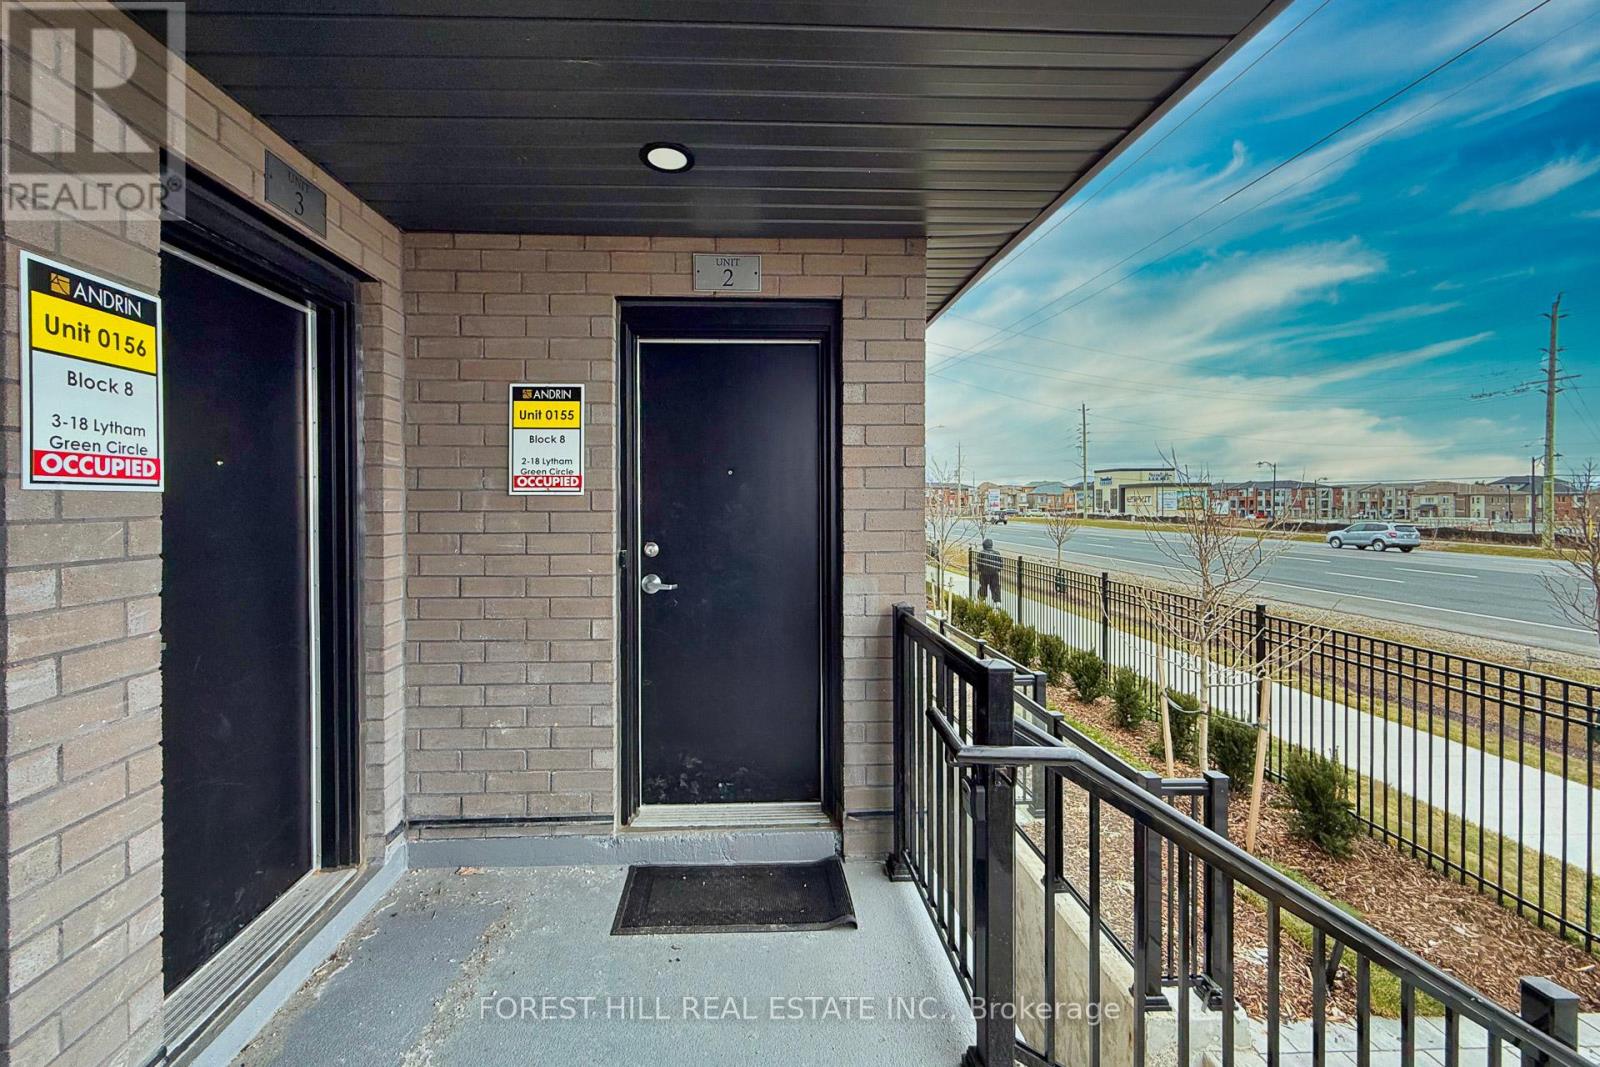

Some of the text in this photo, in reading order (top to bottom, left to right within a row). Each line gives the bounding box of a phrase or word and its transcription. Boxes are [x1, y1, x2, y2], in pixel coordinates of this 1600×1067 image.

[294, 191, 304, 216] 3
[715, 258, 741, 267] UNIT
[722, 268, 734, 287] 2
[73, 282, 143, 319] ANDRIN
[44, 313, 147, 358] Unit 0156
[67, 370, 134, 397] Block 8
[533, 389, 572, 400] ANDRIN
[519, 409, 574, 420] Unit 0155
[51, 413, 146, 437] 3-18 Lytham
[49, 435, 148, 456] Green Circle
[529, 434, 566, 444] Block 8
[40, 452, 157, 478] OCCUPIED
[521, 457, 573, 466] 2-18 Lytham
[549, 467, 574, 475] Circle
[516, 476, 579, 487] OCCUPIED
